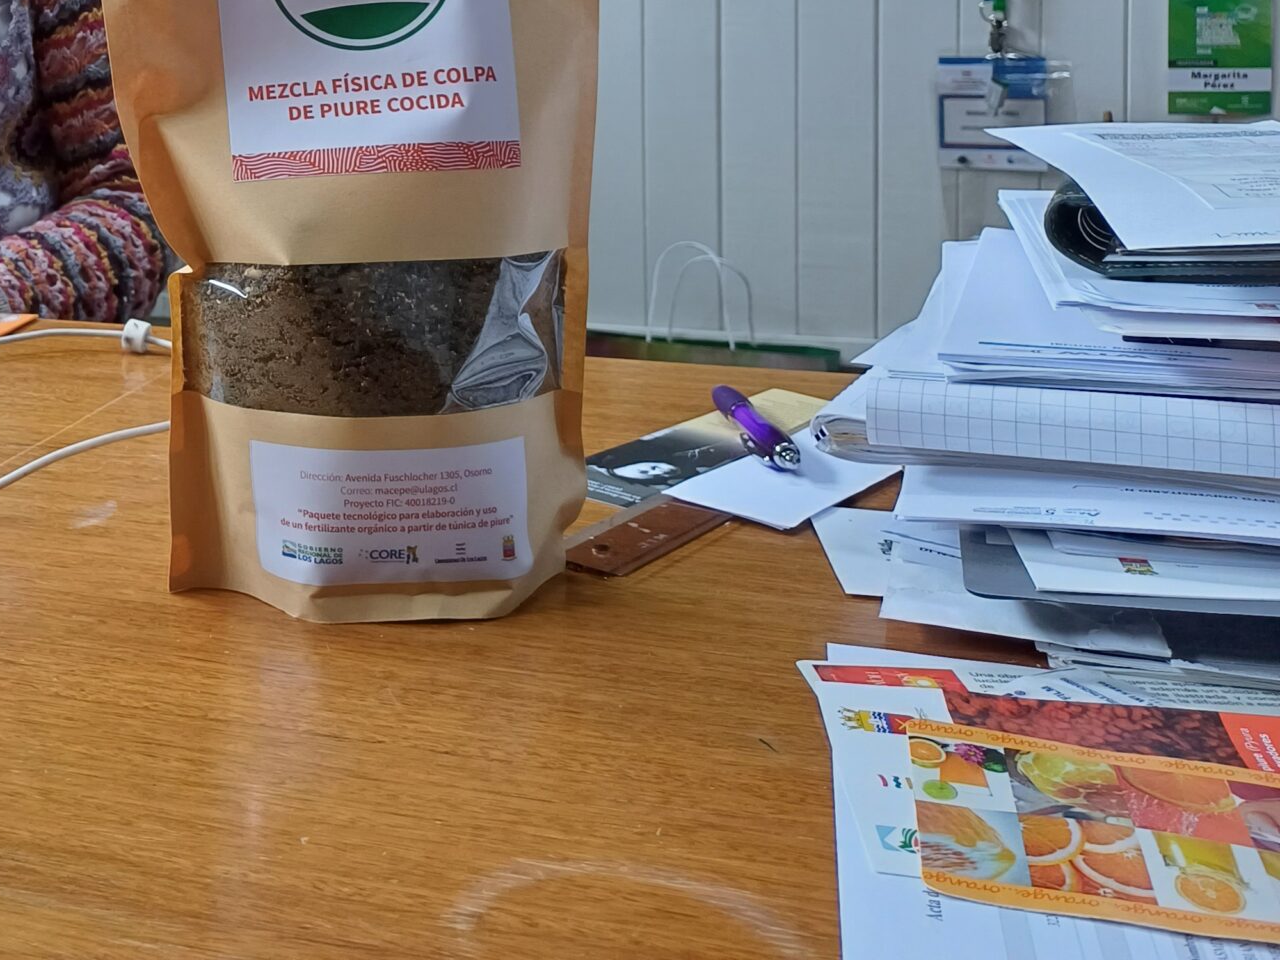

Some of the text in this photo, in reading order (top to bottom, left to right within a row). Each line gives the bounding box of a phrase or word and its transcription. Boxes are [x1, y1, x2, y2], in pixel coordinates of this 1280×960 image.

[247, 65, 497, 102] MEZCLA FÍSICA DE COLPA
[288, 91, 465, 121] DE PIURE COCIDA
[299, 467, 493, 483] Dirección: Avenida Fuschlocher 1305, Osorno
[340, 483, 459, 497] Correo: macepe@ulagos.cl
[343, 496, 456, 511] Proyecto FIC: 40018219-0
[343, 510, 398, 523] tecnológico
[399, 512, 420, 523] para
[421, 506, 474, 519] elaboración
[475, 508, 483, 518] y
[483, 506, 498, 515] uso
[280, 517, 290, 528] de
[292, 521, 303, 530] un
[304, 520, 356, 534] fertilizante
[357, 522, 398, 536] orgánico
[407, 520, 434, 534] partir
[435, 520, 447, 531] de
[448, 517, 477, 530] túnica
[478, 518, 489, 528] de
[297, 543, 344, 553] GOBIERNO
[297, 548, 332, 558] REGIONAL
[369, 548, 406, 561] CORE
[297, 555, 344, 565] LOS LAGOS
[925, 898, 944, 922] Acta
